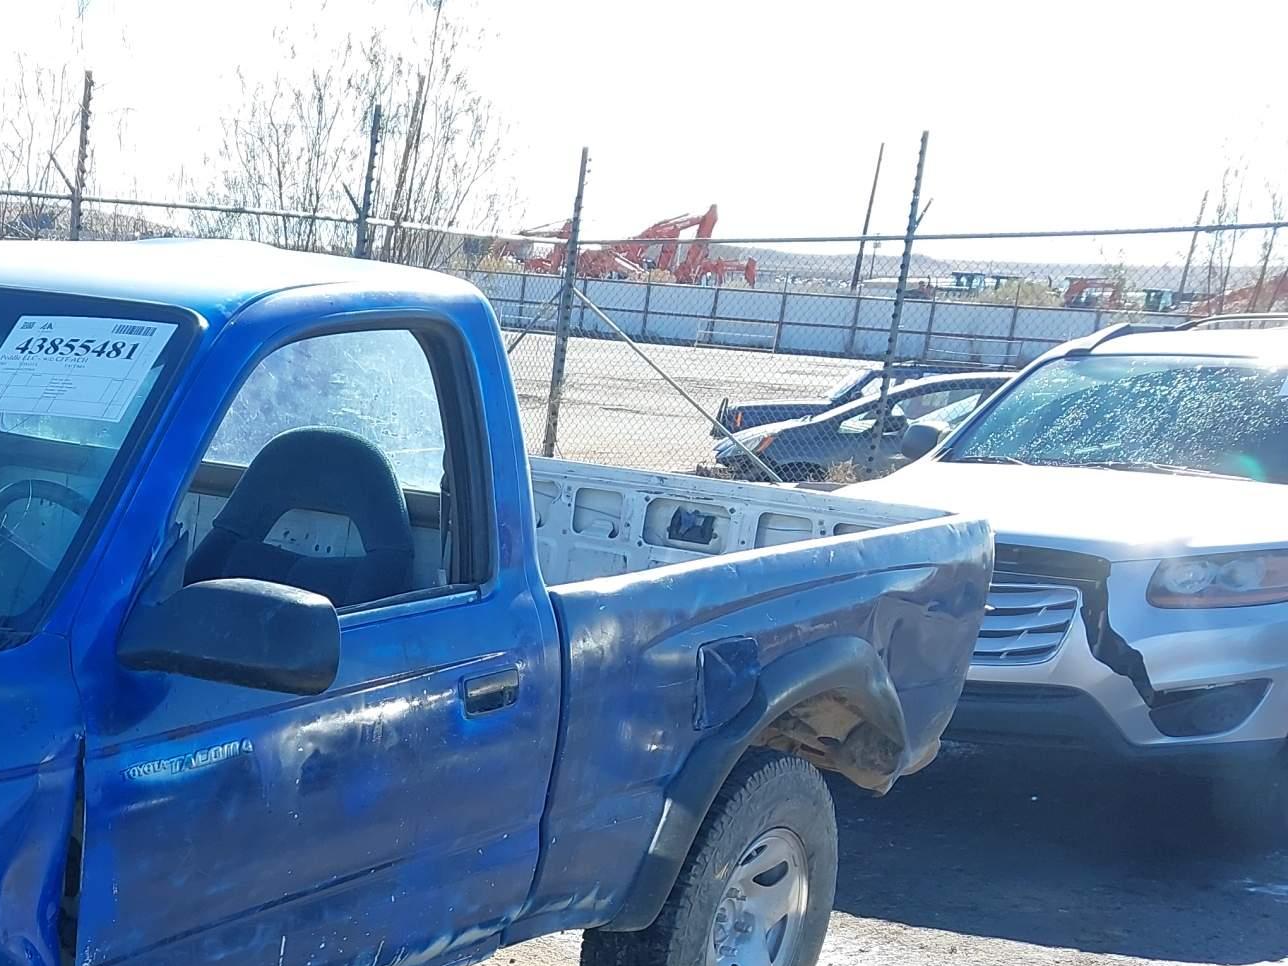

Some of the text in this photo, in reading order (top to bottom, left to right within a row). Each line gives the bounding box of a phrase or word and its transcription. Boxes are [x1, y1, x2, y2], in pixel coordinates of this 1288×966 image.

[15, 336, 140, 360] 43855481
[120, 737, 255, 782] TOYOTA TACOMA
